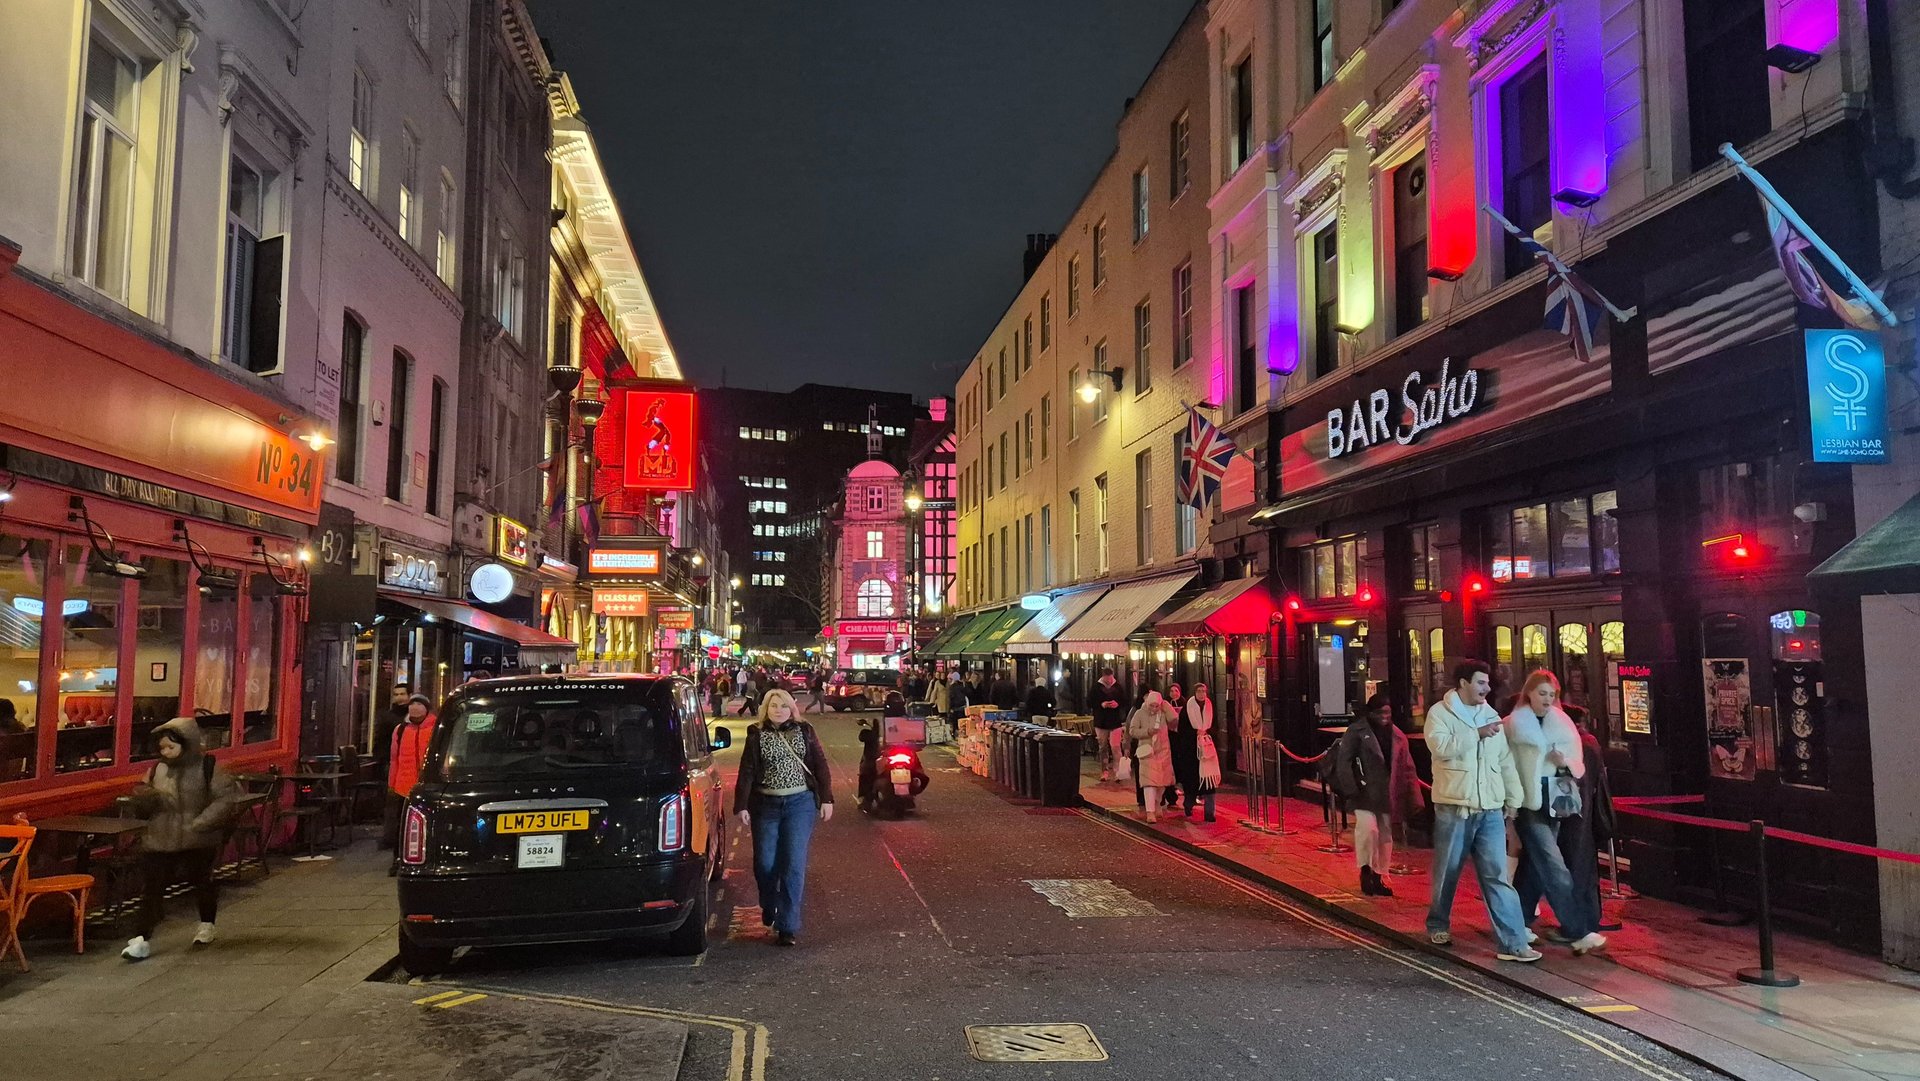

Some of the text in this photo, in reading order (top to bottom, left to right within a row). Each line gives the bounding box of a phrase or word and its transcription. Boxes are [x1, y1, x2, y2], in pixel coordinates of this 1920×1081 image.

[318, 360, 339, 382] TO LET
[1328, 356, 1478, 459] BAR Soho
[1820, 439, 1882, 448] LESBIAN BAR
[105, 473, 119, 493] ALL
[120, 477, 137, 498] DAY
[139, 482, 154, 502] ALL
[324, 529, 343, 565] 32
[392, 552, 438, 585] DOZO
[604, 594, 627, 602] CLASS
[1619, 665, 1634, 676] BAR
[494, 684, 625, 692] SHERBETLONDON.COM
[503, 813, 581, 830] LM73 UFL
[526, 847, 554, 855] 58824
